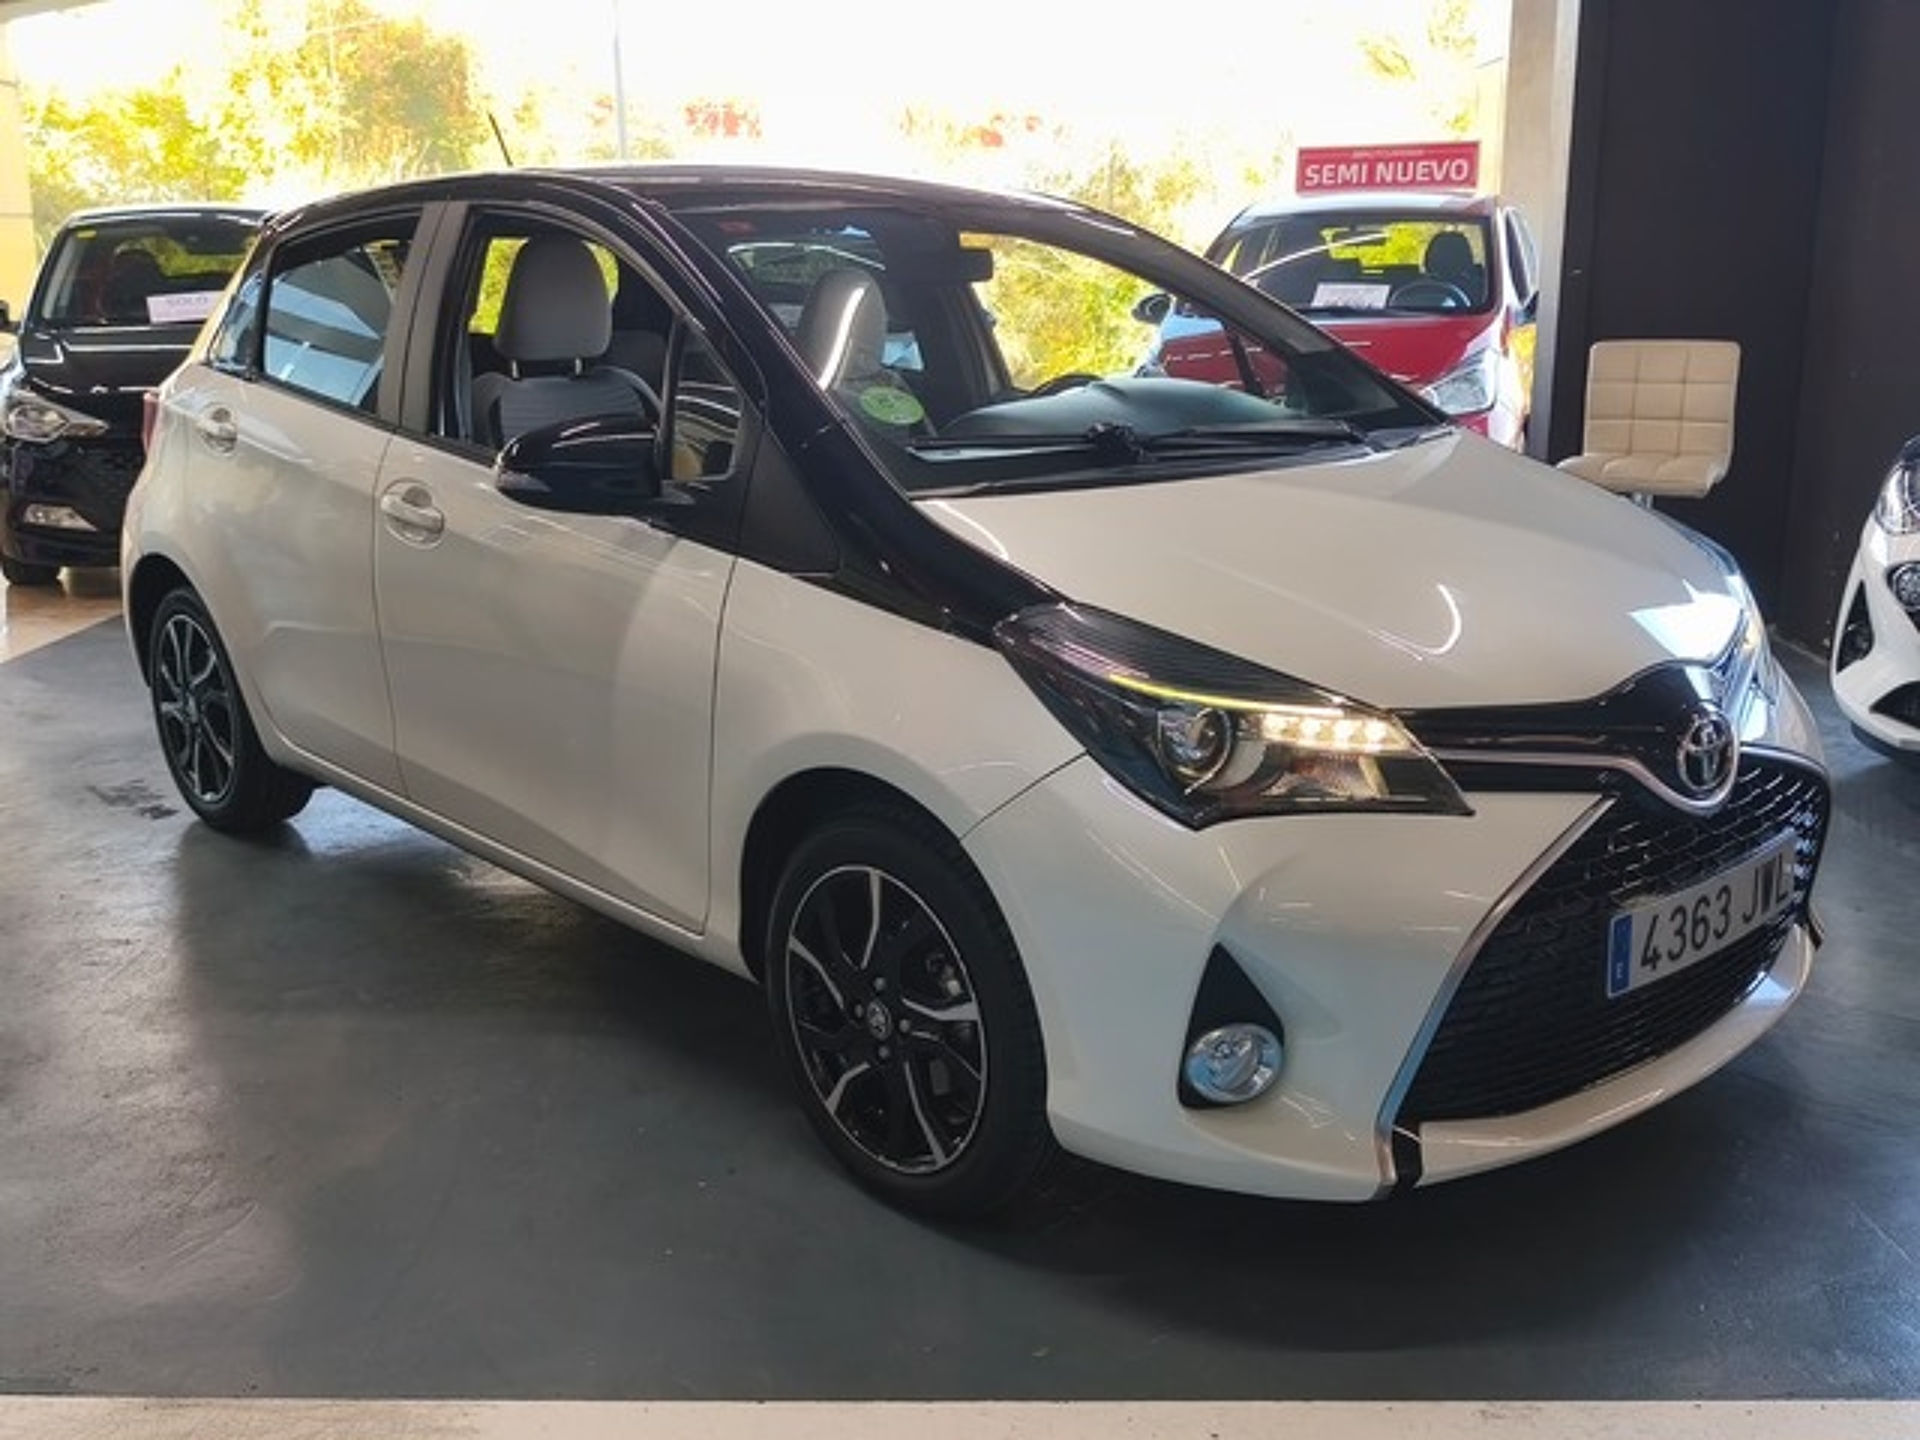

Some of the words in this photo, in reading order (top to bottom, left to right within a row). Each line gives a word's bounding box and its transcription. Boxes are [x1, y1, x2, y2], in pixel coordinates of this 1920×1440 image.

[1304, 163, 1368, 187] SEMI
[1375, 159, 1469, 183] NUEVO
[1640, 884, 1732, 970] 4363
